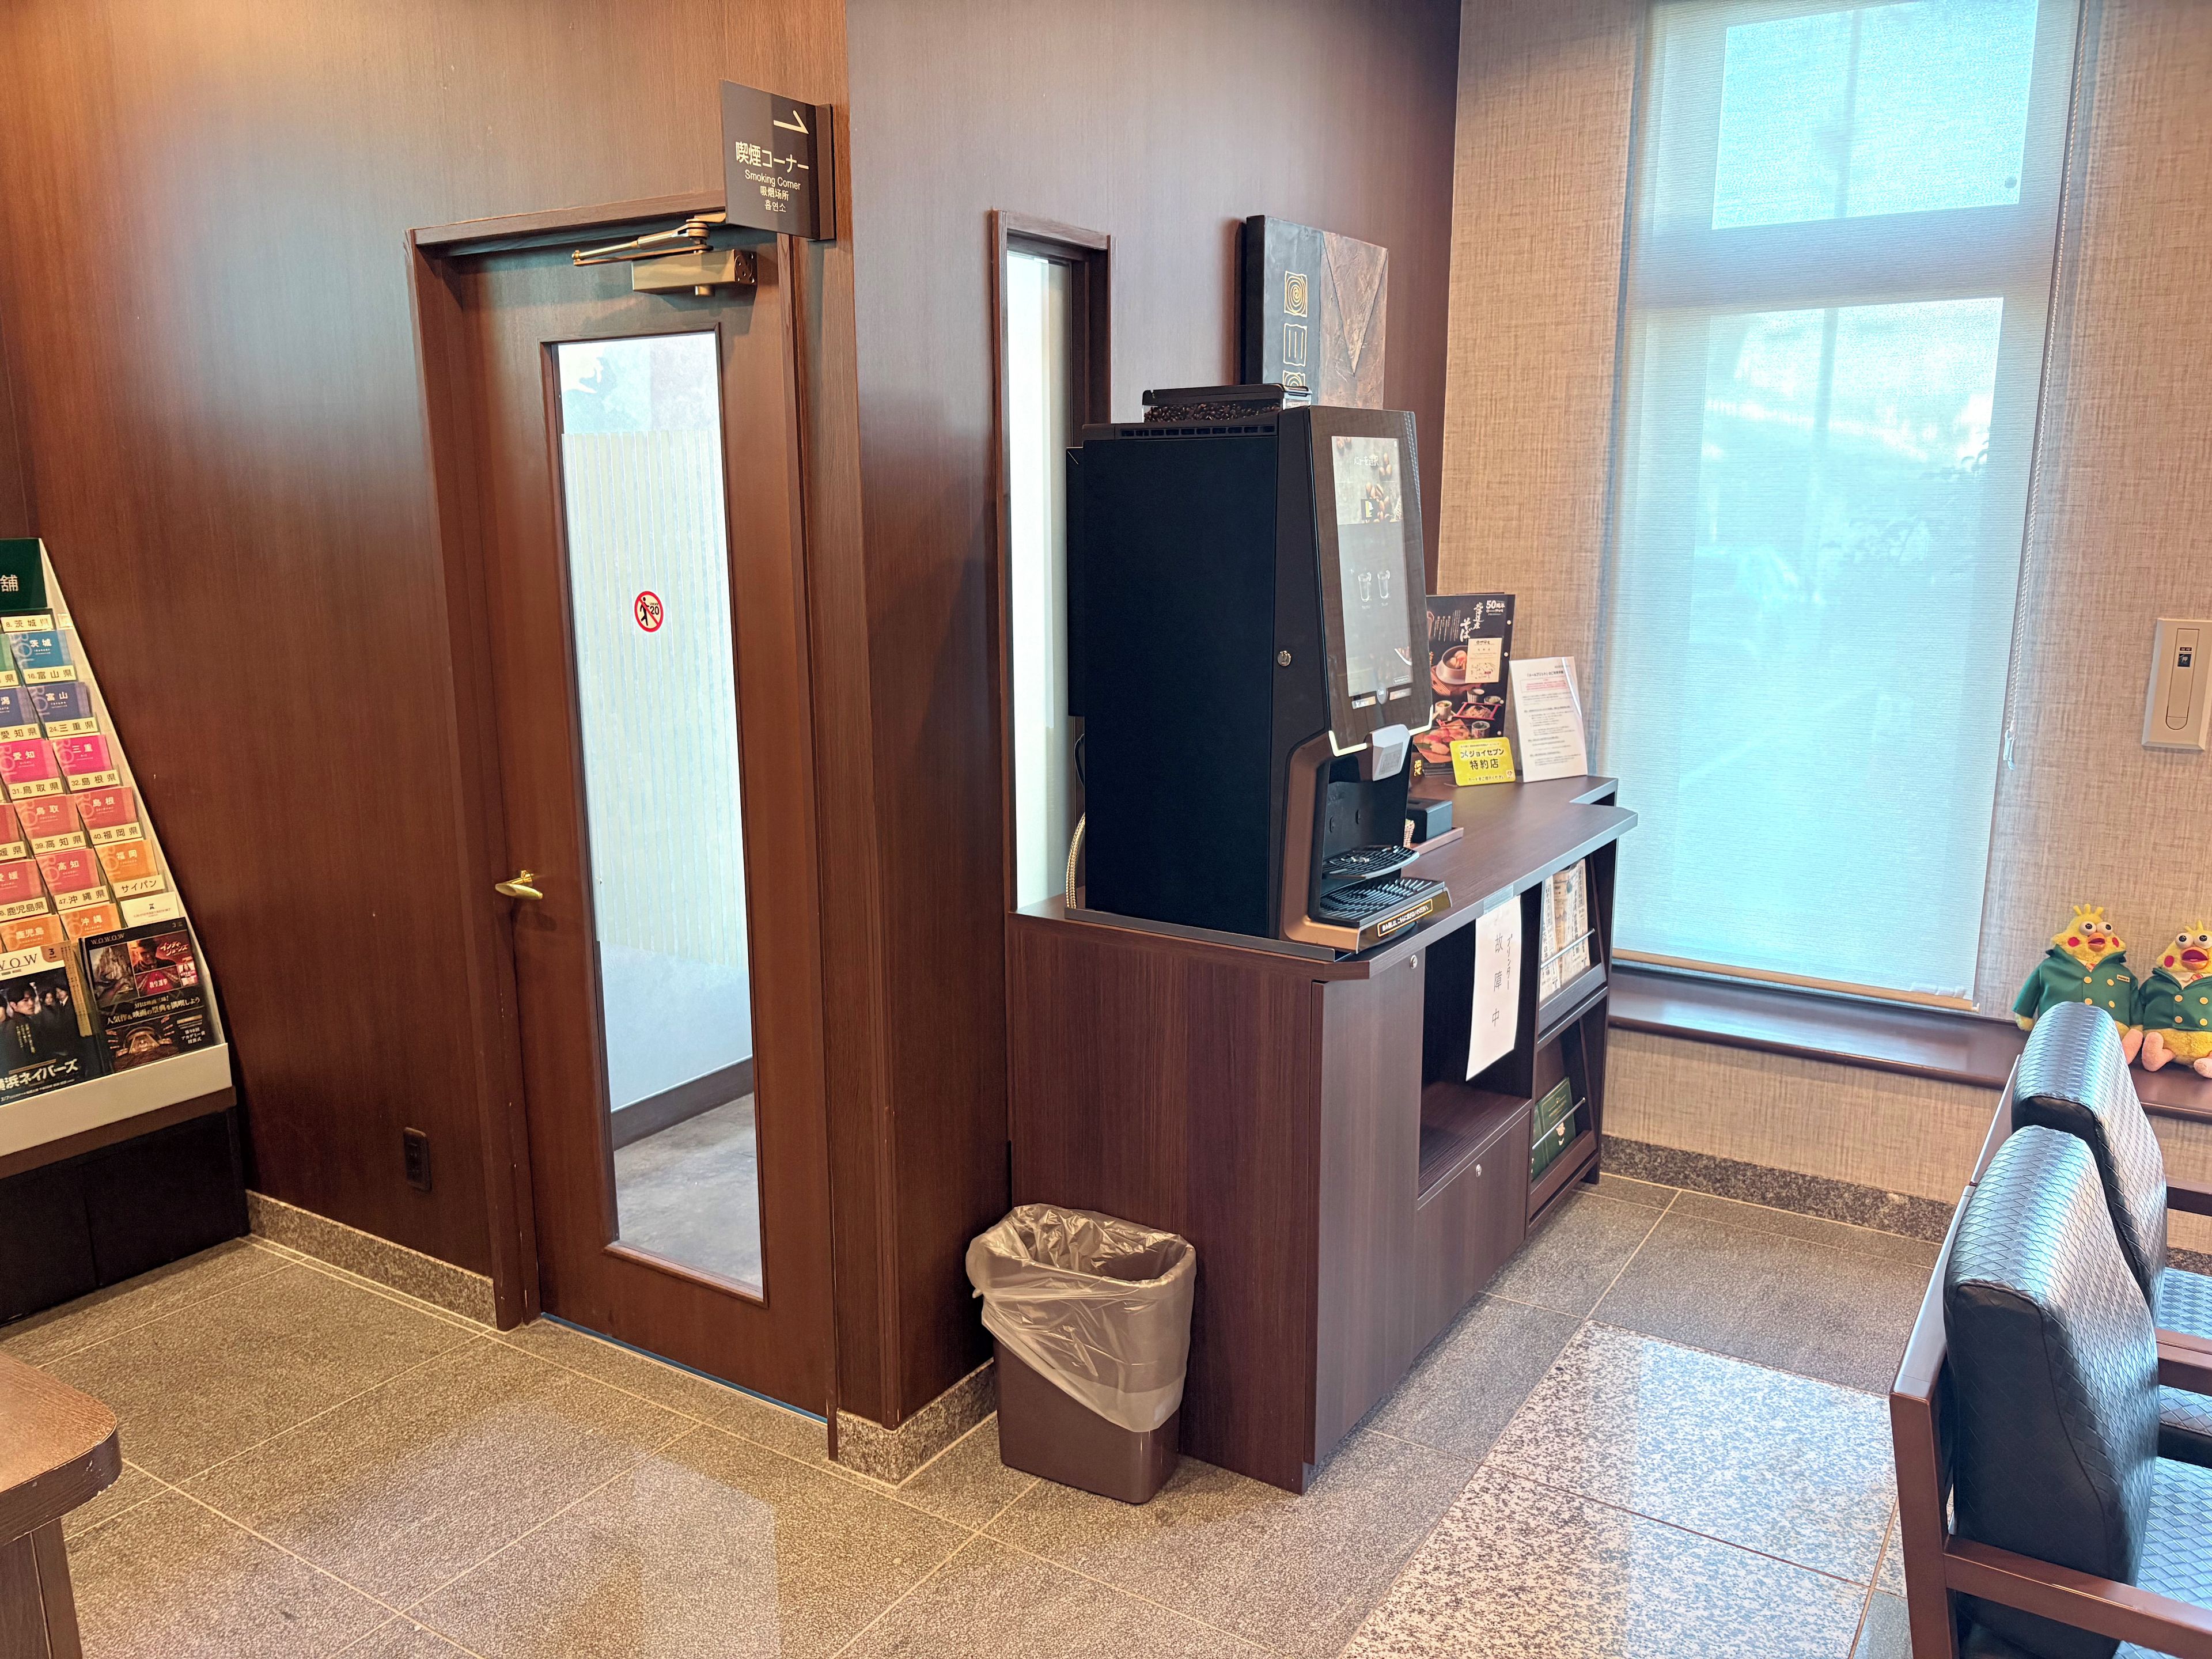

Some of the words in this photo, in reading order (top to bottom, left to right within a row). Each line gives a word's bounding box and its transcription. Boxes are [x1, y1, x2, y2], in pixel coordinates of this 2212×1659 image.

[735, 141, 809, 173] 喫煙コーナー
[745, 169, 775, 187] Smoking
[777, 176, 801, 190] Corner
[760, 186, 789, 201] 吸烟场所
[764, 199, 786, 213] 흡연소
[0, 574, 18, 592] 舗
[650, 606, 659, 615] 20
[28, 669, 73, 679] 16.富山県
[46, 691, 68, 701] 富山
[49, 721, 94, 732] 24.三重県
[1, 727, 38, 739] 愛知県
[72, 744, 93, 753] 三重
[13, 751, 35, 760] 愛知
[1469, 759, 1499, 770] 特約店
[71, 773, 116, 786] 32.島根県
[12, 782, 59, 794] 31.鳥取県
[93, 797, 115, 807] 島根
[36, 805, 59, 815] 鳥取
[93, 826, 139, 839] 40.福岡県
[35, 835, 85, 849] 39.高知県
[116, 849, 138, 860] 福岡
[58, 861, 79, 871] 高知
[122, 880, 157, 893] サイパン
[59, 889, 105, 904] 47.沖縄県
[81, 915, 103, 926] 沖縄
[16, 927, 44, 940] 鹿児島
[90, 933, 125, 945] WOWOW
[1491, 933, 1503, 1027] 故障中
